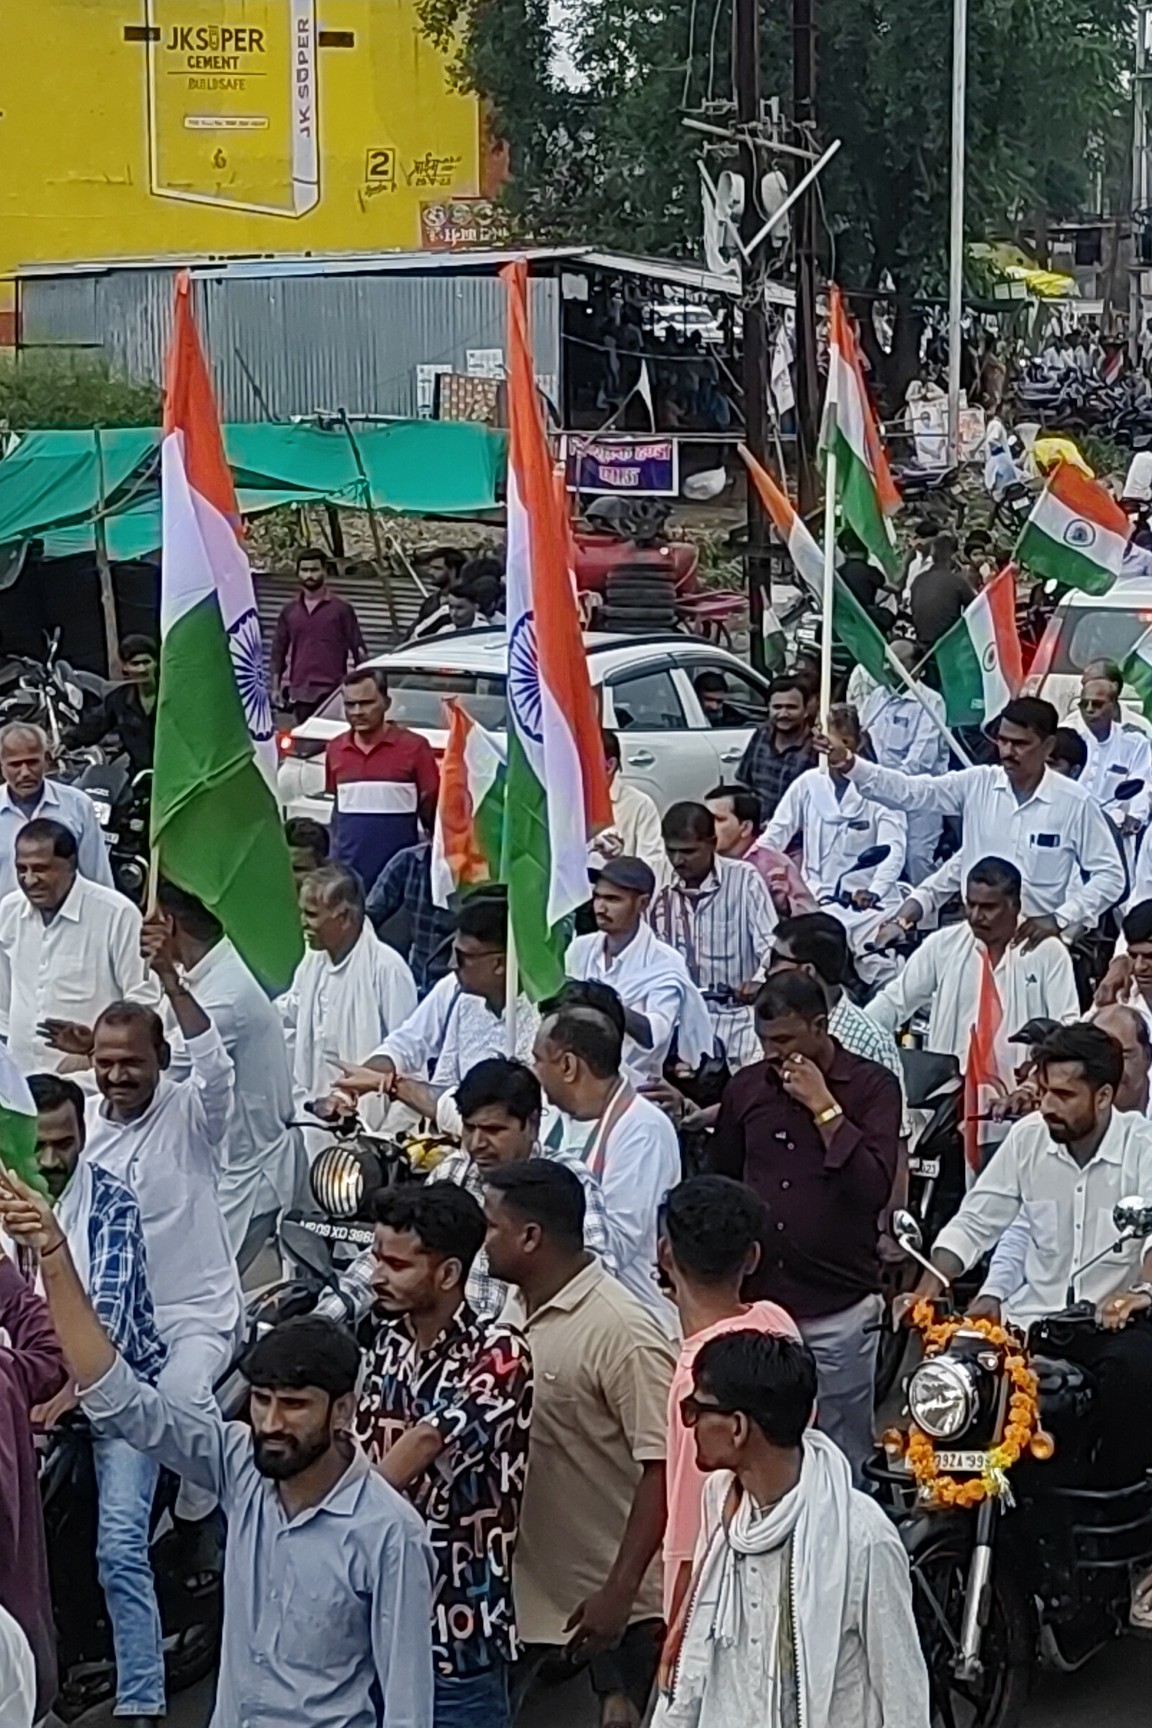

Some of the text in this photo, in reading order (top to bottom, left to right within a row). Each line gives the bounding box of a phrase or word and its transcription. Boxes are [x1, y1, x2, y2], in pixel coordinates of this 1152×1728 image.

[187, 56, 240, 70] CEMENT
[297, 18, 310, 138] JK SUPER
[370, 152, 390, 175] 2
